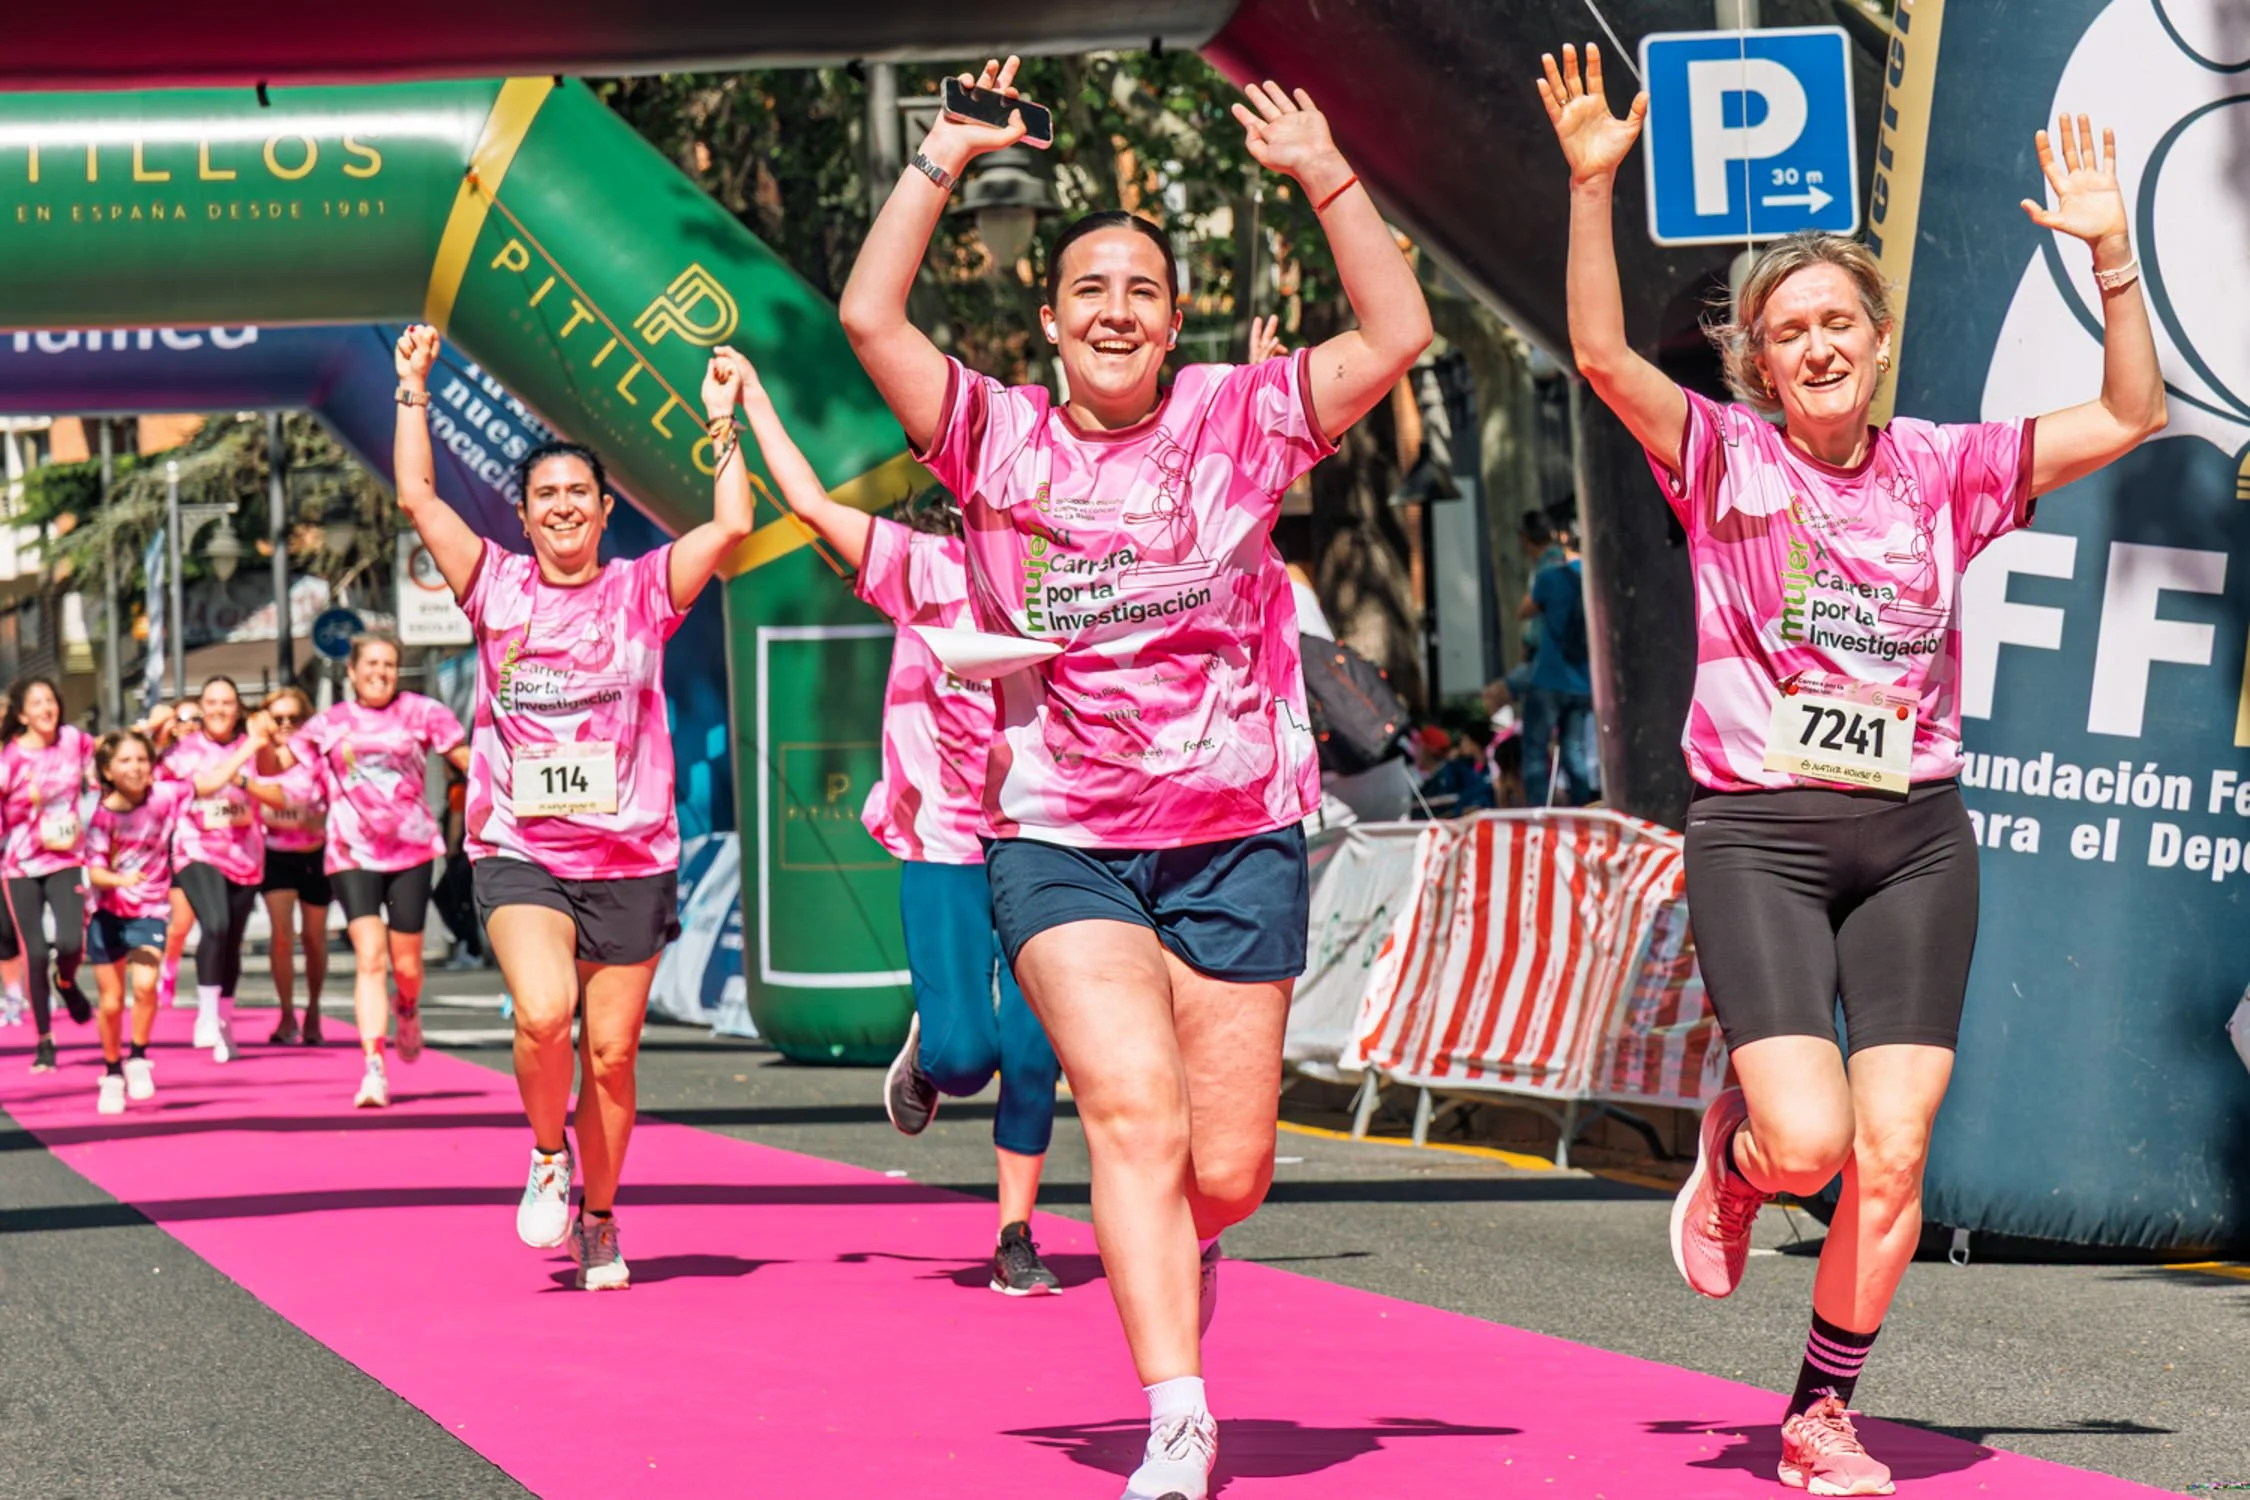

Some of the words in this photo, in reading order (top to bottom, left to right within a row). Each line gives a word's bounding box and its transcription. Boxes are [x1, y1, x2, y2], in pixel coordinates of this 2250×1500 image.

[1687, 58, 1808, 216] P
[1771, 168, 1799, 185] 30
[1806, 170, 1823, 184] m
[17, 206, 51, 222] EN
[73, 202, 187, 222] ESPAÑA
[207, 203, 301, 220] DESDE
[323, 201, 386, 218] 1981
[1046, 582, 1082, 608] por
[1090, 583, 1114, 601] la
[1780, 534, 1815, 642] mujer
[1048, 586, 1211, 632] Investigación
[1811, 599, 1851, 621] por
[1855, 605, 1876, 627] la
[1809, 624, 1943, 662] Investigació
[514, 681, 542, 695] por
[1799, 704, 1886, 758] 7241
[540, 766, 589, 793] 114
[2069, 818, 2121, 863] el
[2147, 821, 2250, 882] Dep
